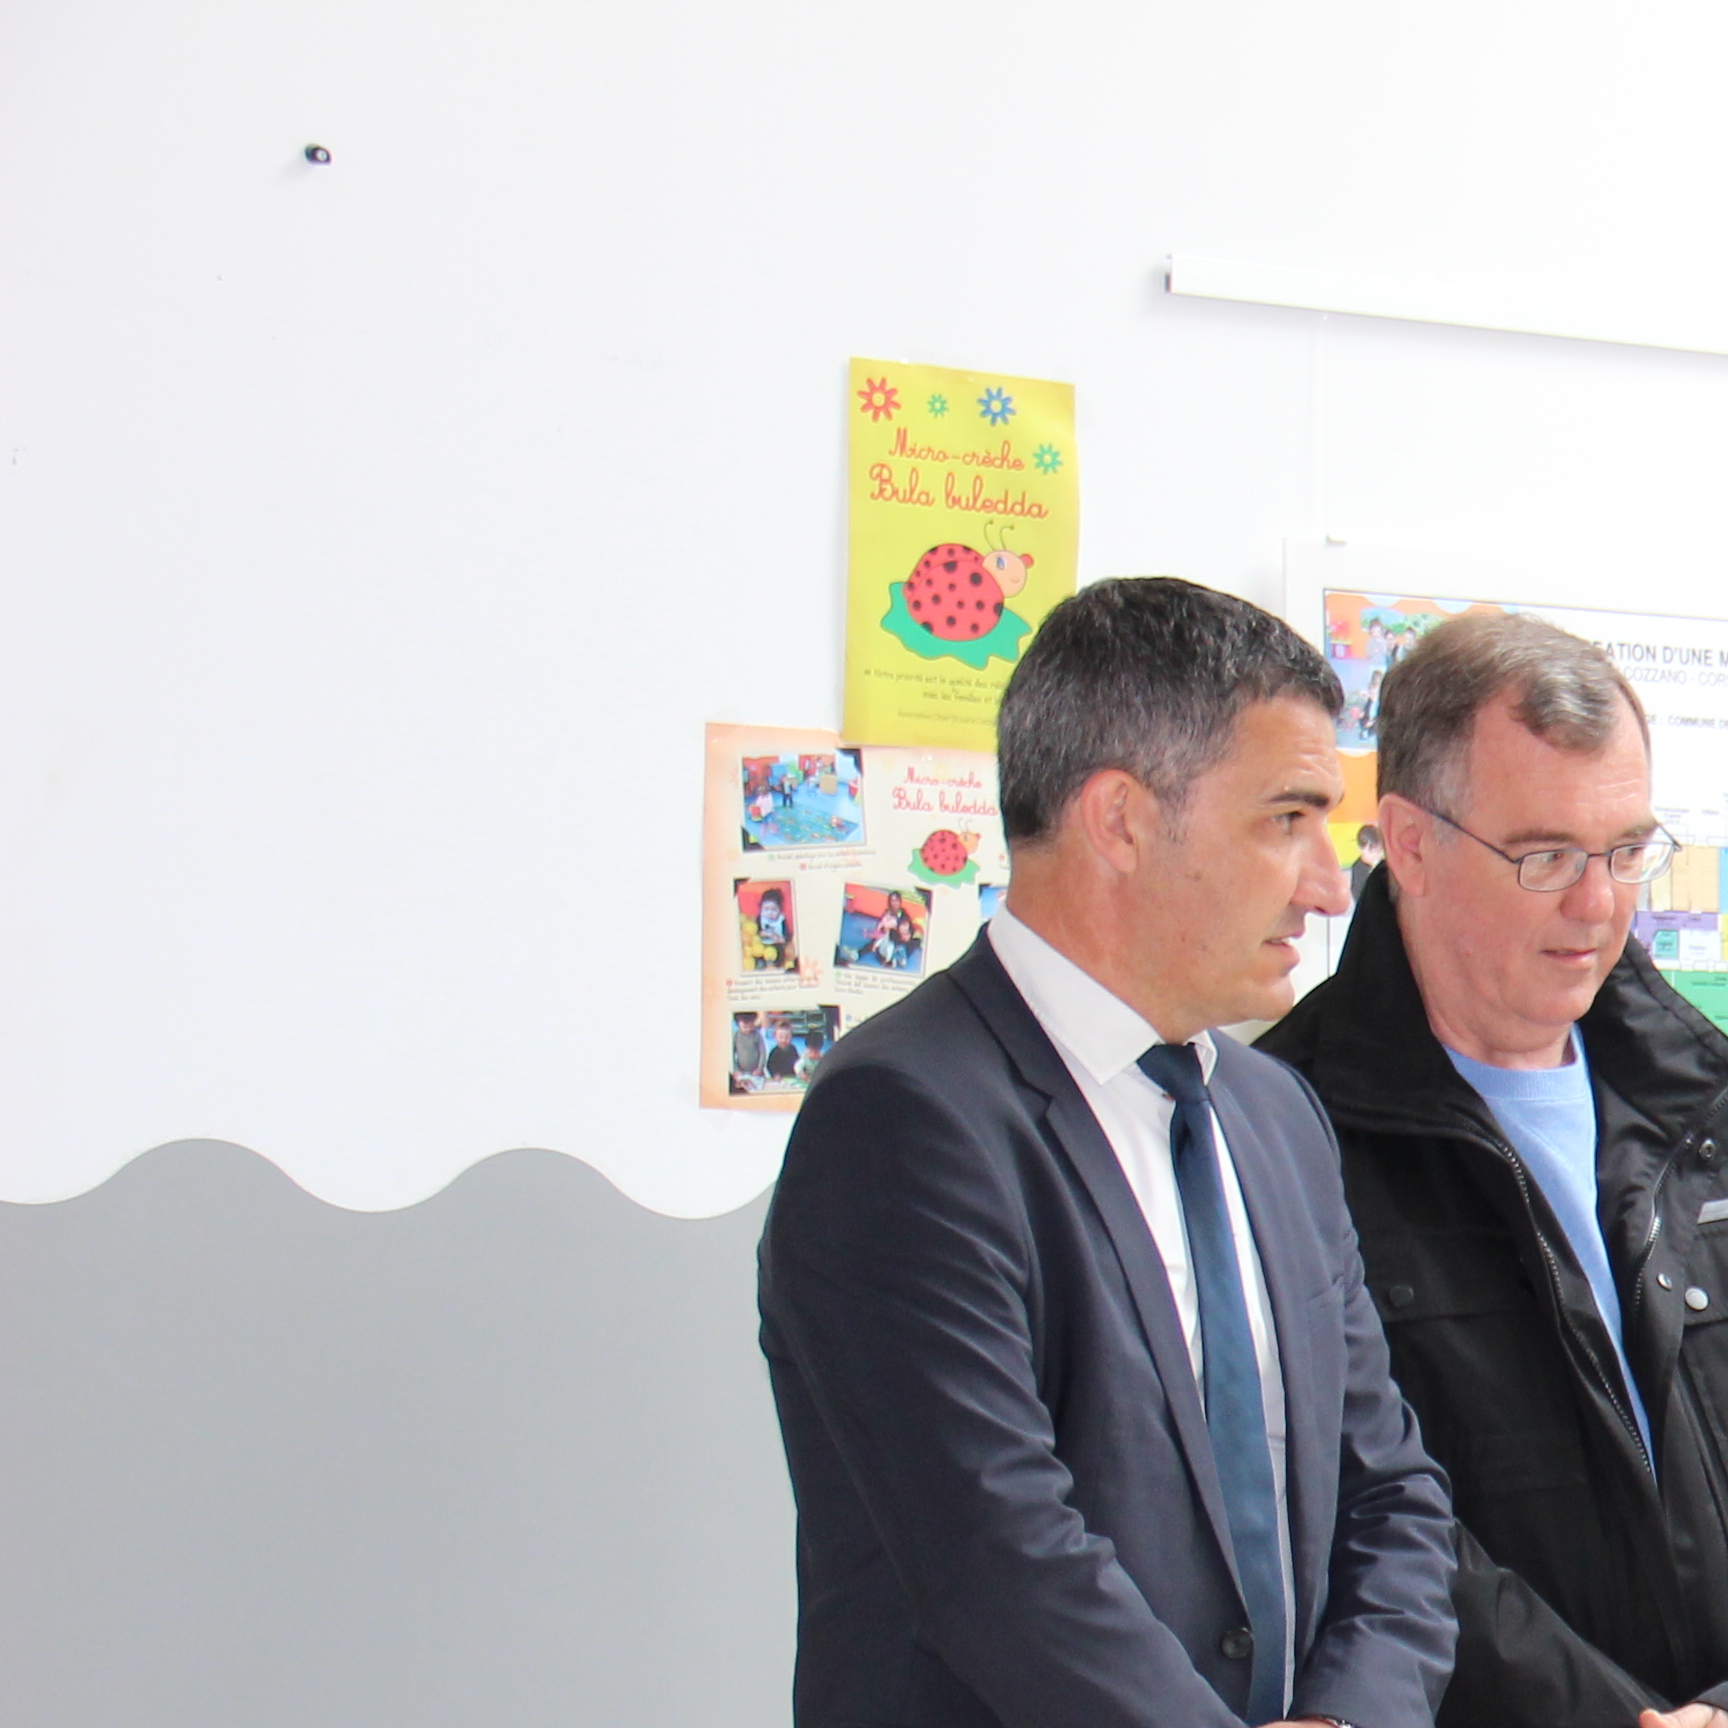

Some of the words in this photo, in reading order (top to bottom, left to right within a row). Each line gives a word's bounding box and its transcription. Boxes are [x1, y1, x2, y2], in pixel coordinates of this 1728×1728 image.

[888, 427, 1025, 471] Micro-crèche
[869, 463, 935, 506] Bula
[944, 472, 1049, 519] buledda
[1662, 646, 1713, 667] D'UNE
[1625, 665, 1687, 685] COZZANO
[1668, 715, 1716, 729] COMMUNE
[892, 787, 934, 812] Bula
[939, 790, 999, 817] buledda
